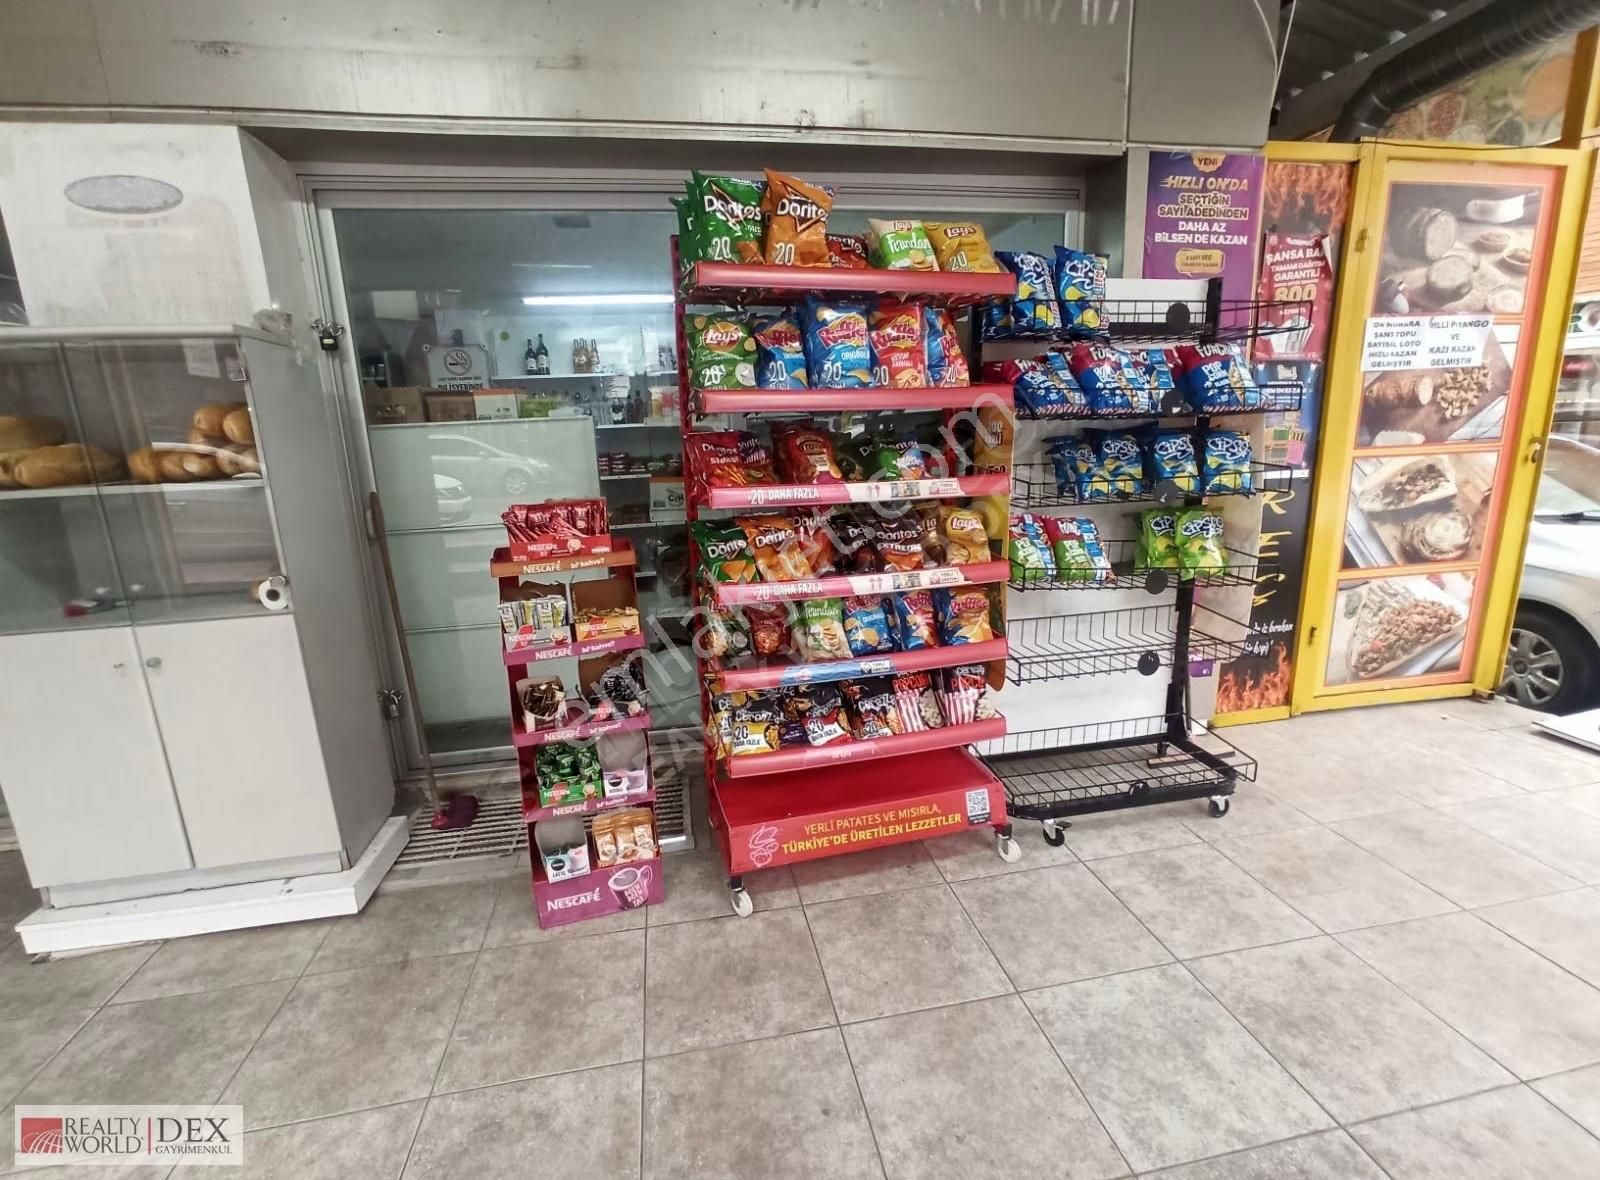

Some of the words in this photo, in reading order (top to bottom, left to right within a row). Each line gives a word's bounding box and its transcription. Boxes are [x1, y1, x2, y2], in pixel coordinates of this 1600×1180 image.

[1166, 175, 1204, 190] HIZLI
[1206, 177, 1248, 191] ON'DA
[1179, 192, 1230, 207] SEÇTİĞİN
[703, 194, 762, 222] Doritos
[1158, 205, 1185, 217] SAYI
[1185, 207, 1249, 220] ADEDİNDEN
[1178, 221, 1210, 232] DAHA
[1211, 223, 1228, 233] AZ
[1154, 232, 1193, 244] BİLSEN
[1194, 234, 1209, 245] DE
[1209, 235, 1249, 246] KAZAN
[1265, 249, 1305, 266] ŞANSA
[1399, 340, 1422, 348] LOTO
[1450, 333, 1461, 341] VE
[1429, 346, 1449, 355] KAZI
[768, 488, 794, 501] DAHA
[793, 487, 820, 500] FAZLA
[523, 560, 561, 575] NESCAFÉ
[798, 582, 824, 594] FAZLA
[535, 645, 573, 661] NESCAFÉ
[543, 727, 581, 742] NESCAFÉ
[552, 801, 588, 817] NESCAFÉ
[803, 819, 834, 836] YERLİ
[836, 812, 881, 829] PATATES
[883, 811, 896, 822] VE
[898, 803, 942, 819] MISIRLA,
[781, 833, 849, 855] TÜRKİYE'DE
[849, 823, 904, 843] ÜRETİLEN
[905, 813, 962, 833] LEZZETLER
[546, 887, 601, 912] NESCAFÉ
